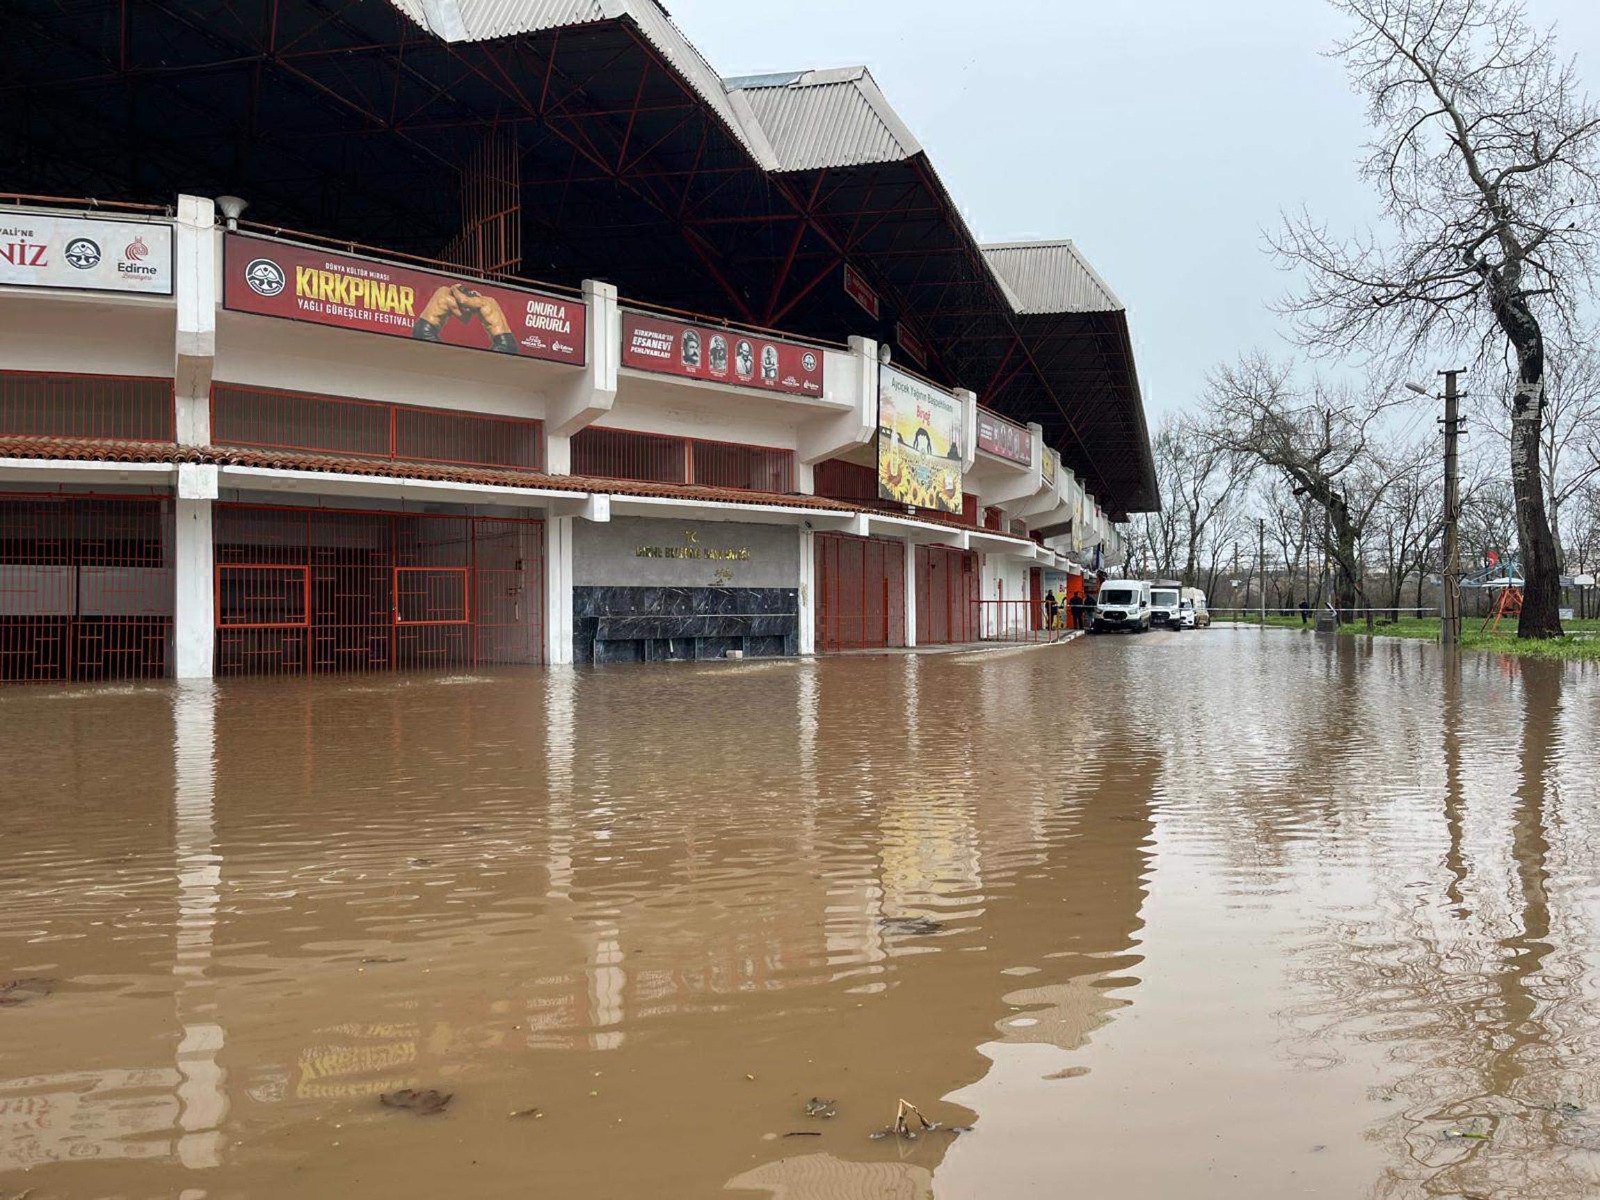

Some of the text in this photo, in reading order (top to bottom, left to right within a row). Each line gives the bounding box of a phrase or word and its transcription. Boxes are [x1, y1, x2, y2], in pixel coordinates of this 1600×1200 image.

[117, 262, 157, 274] Edirne
[325, 262, 345, 272] DÜNYA
[346, 266, 369, 277] KÜLTÜR
[296, 266, 415, 316] KIRKPINAR
[298, 298, 414, 328] YAĞLI GÜREŞLERİ FESTİVALİ
[527, 300, 565, 319] ONURLA
[525, 314, 571, 334] GURURLA
[632, 336, 672, 351] EFSANEVİ
